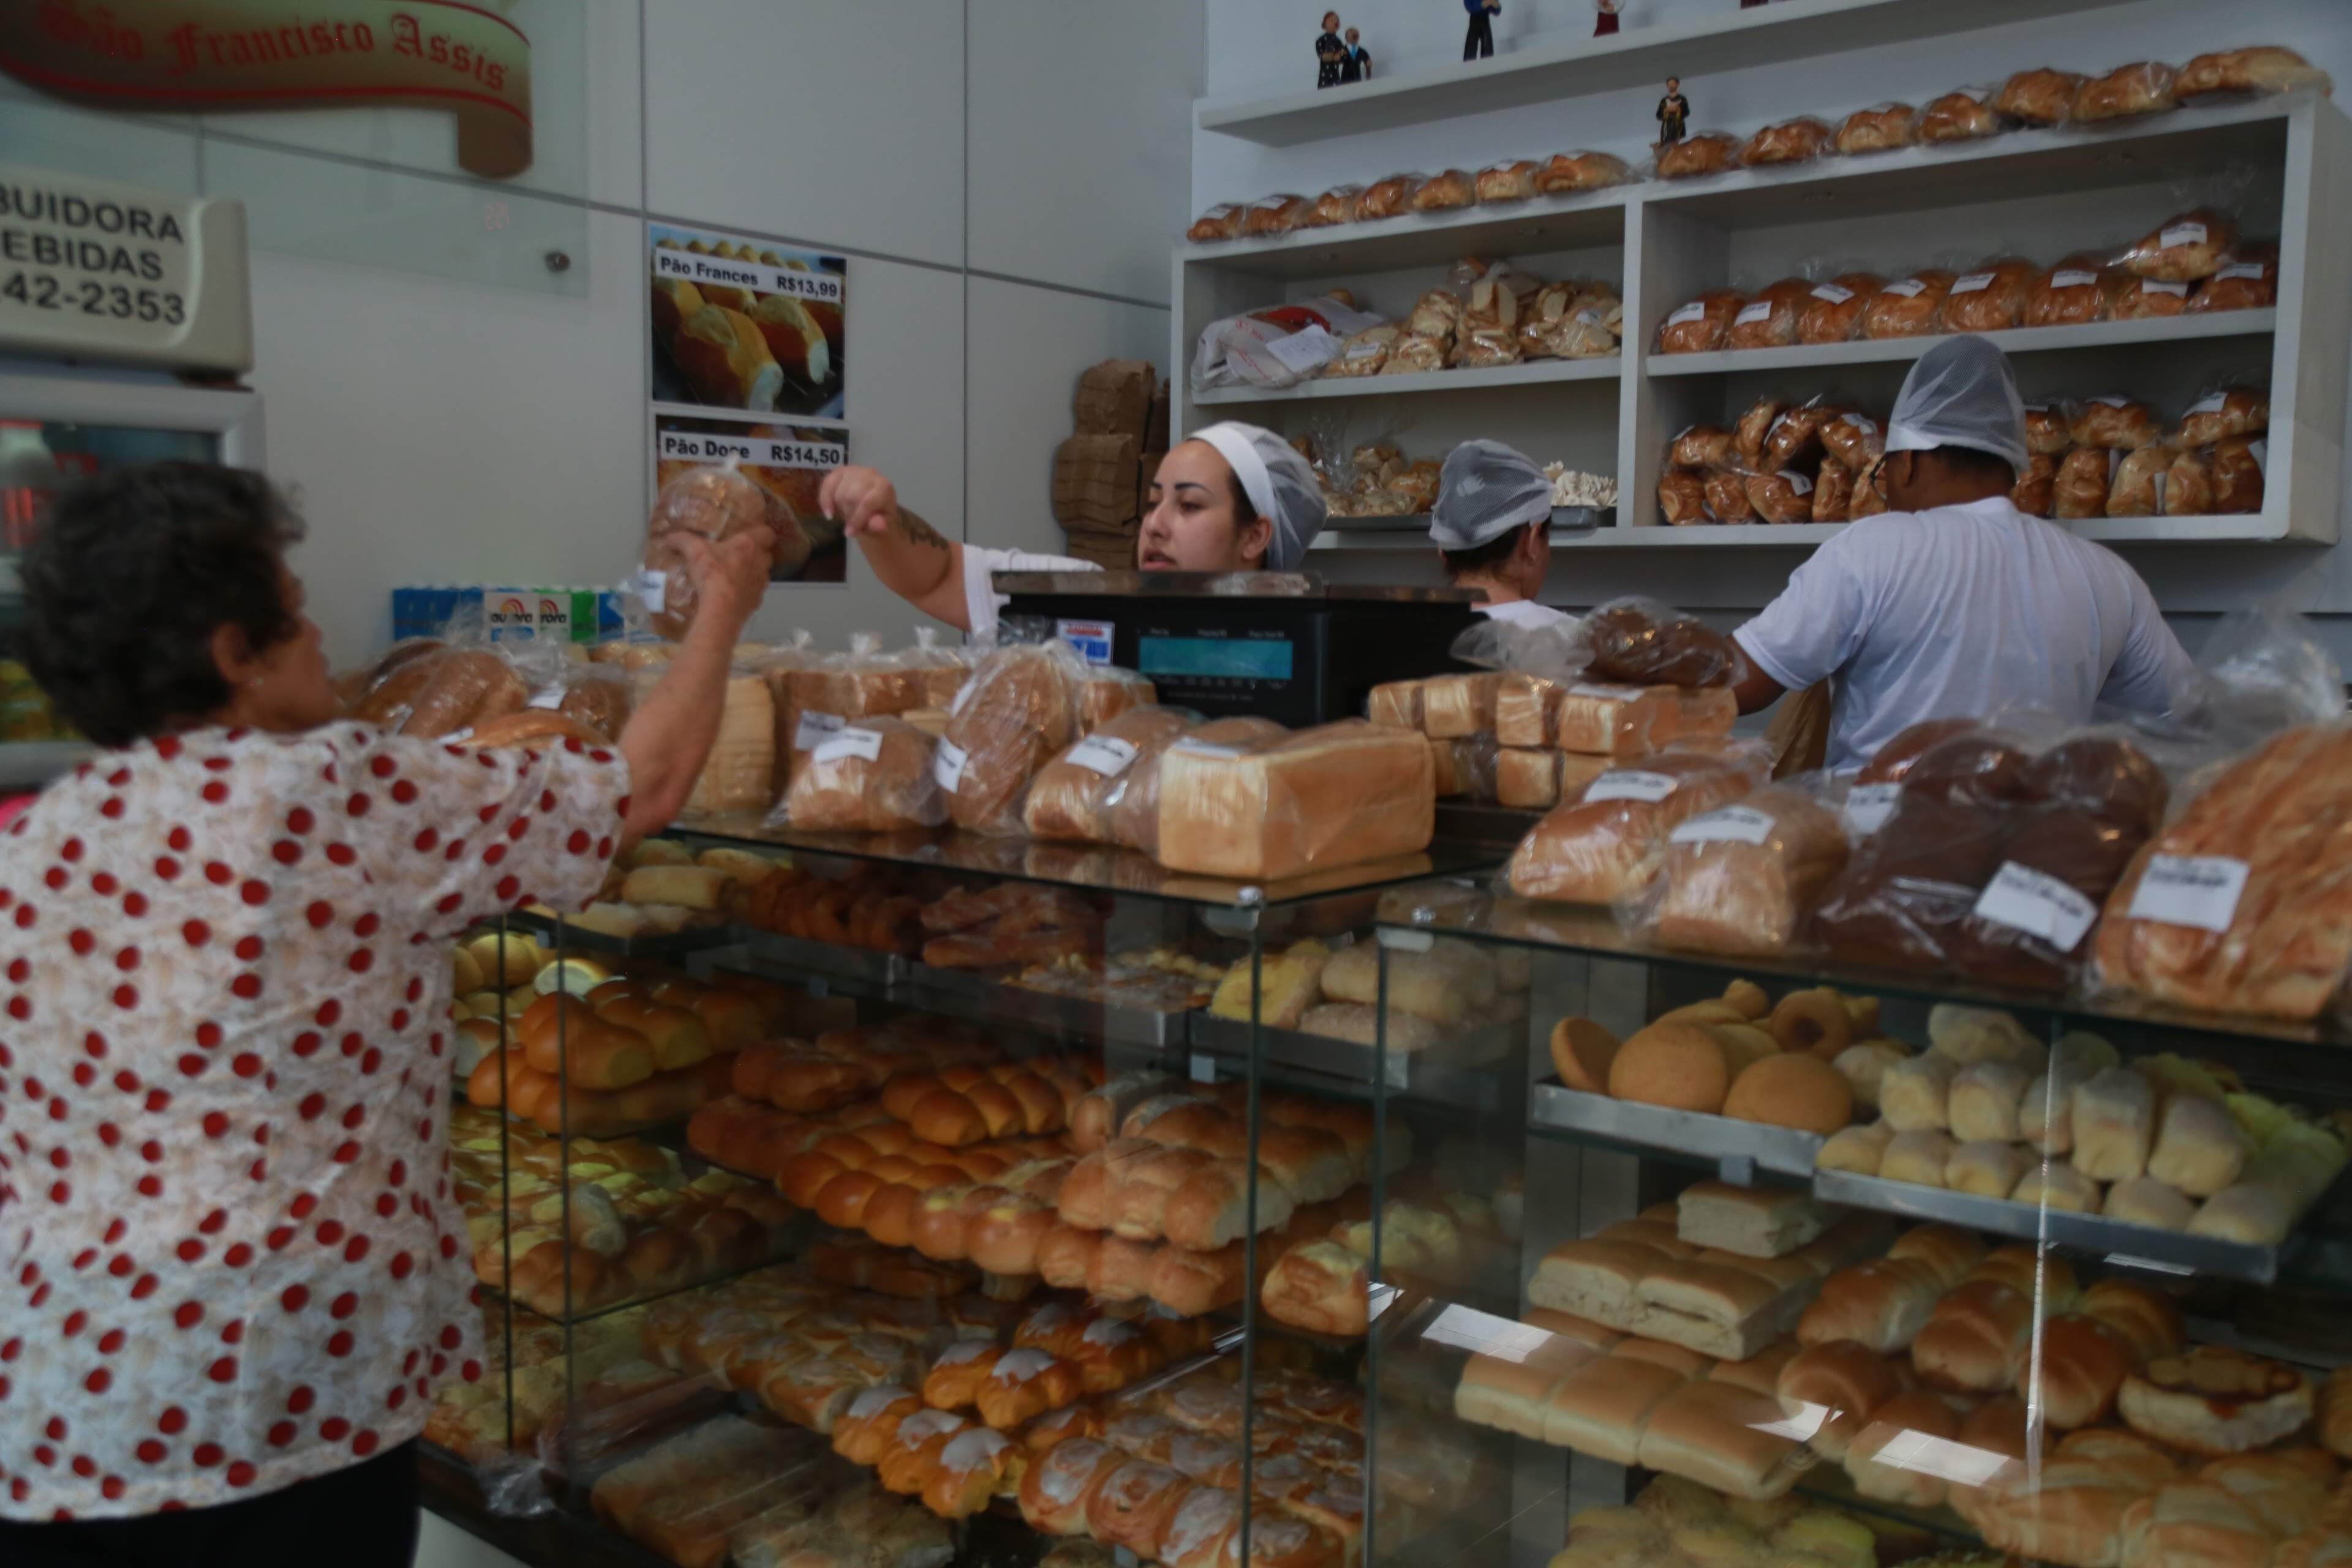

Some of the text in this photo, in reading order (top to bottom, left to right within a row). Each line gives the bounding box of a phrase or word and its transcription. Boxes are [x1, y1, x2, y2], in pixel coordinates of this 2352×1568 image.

[165, 21, 375, 77] Francisco
[390, 12, 510, 91] Assis
[2, 228, 164, 281] EBIDAS
[661, 256, 837, 298] Pão Frances R$13,99
[2, 270, 185, 326] 42-2353
[666, 439, 699, 456] Pão
[771, 445, 840, 466] R$14,50
